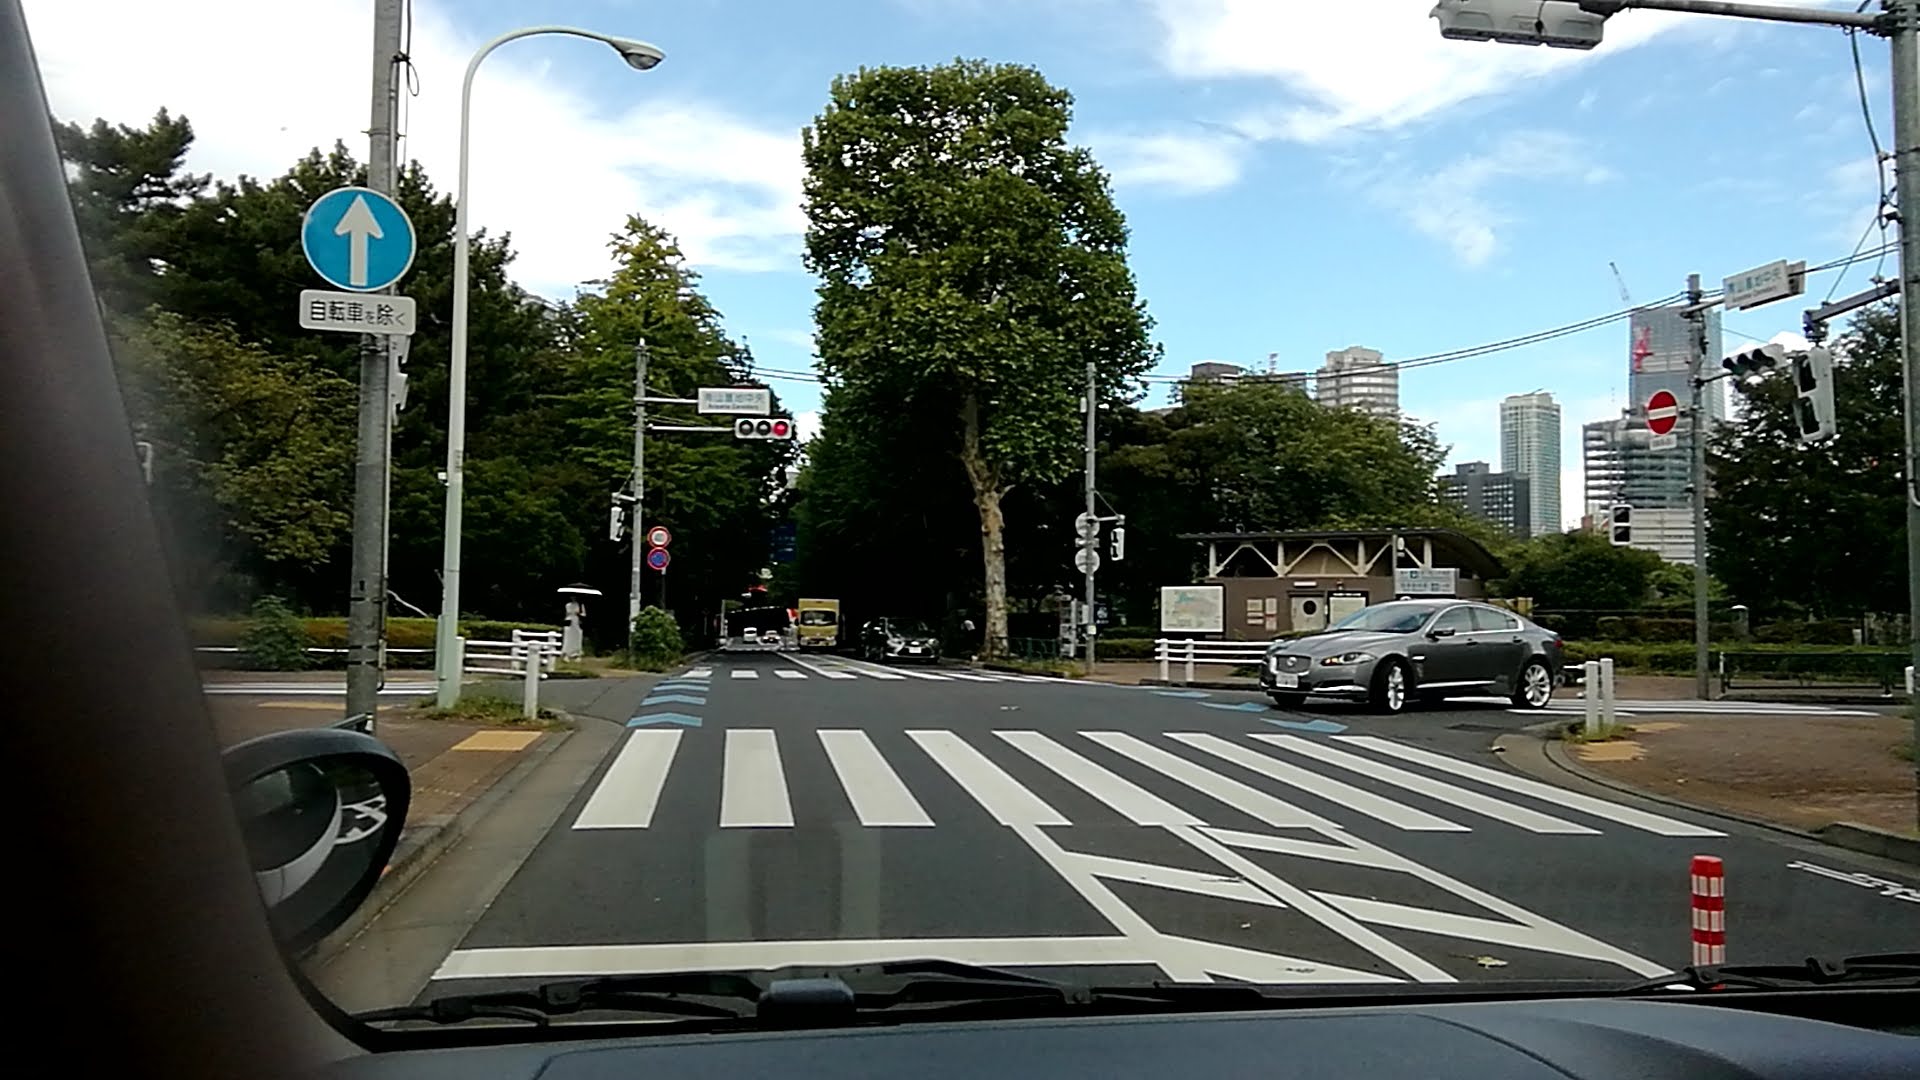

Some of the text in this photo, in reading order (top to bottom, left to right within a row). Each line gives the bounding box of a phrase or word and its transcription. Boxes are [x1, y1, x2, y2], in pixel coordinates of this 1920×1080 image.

[311, 300, 406, 325] 自転車を除く
